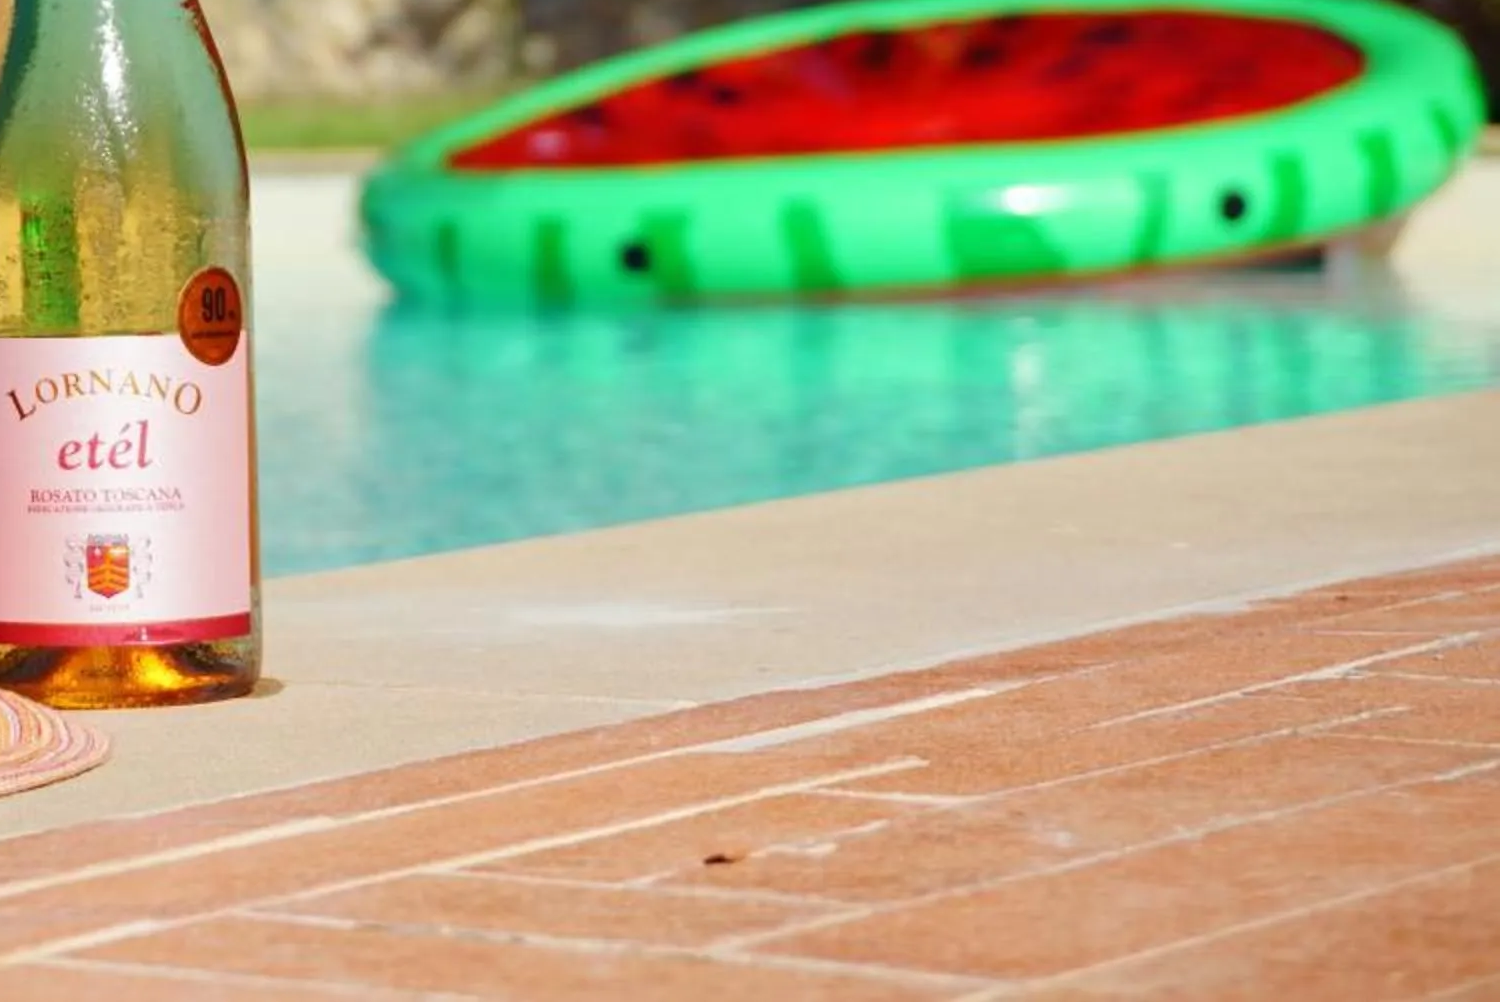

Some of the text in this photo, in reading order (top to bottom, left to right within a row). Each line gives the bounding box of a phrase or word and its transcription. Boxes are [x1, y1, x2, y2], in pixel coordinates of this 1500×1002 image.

[202, 286, 225, 323] 90
[6, 369, 203, 421] LORNANO
[57, 419, 153, 470] etél
[30, 487, 182, 503] ROSATO TOSCANA
